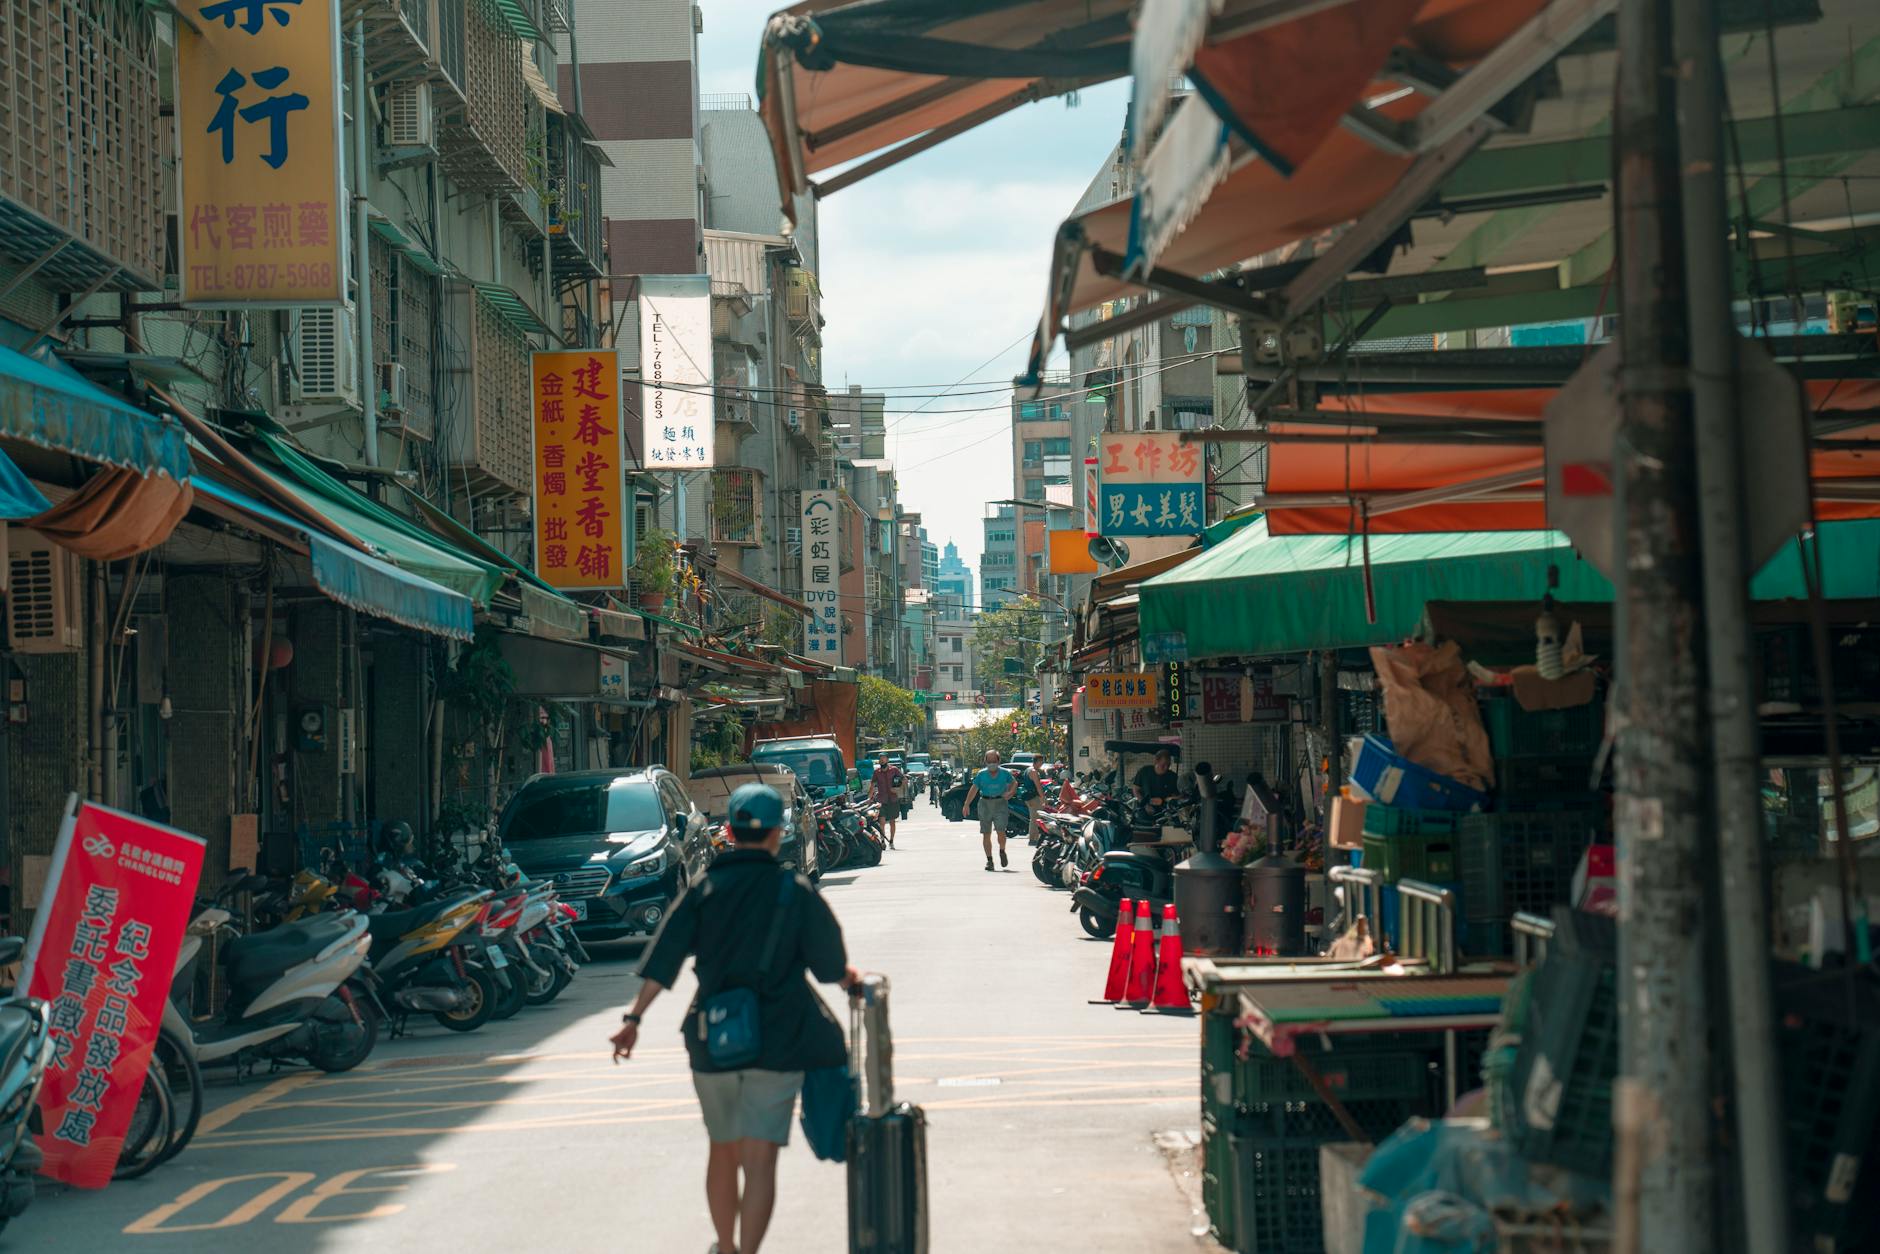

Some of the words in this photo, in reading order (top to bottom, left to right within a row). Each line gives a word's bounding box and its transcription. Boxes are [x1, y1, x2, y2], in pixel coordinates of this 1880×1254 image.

[191, 202, 329, 250] 代客煎藥
[190, 262, 332, 290] TEL:8787-5968
[572, 357, 614, 580] 建春堂香舖
[1103, 438, 1200, 478] 工作坊
[1107, 490, 1199, 529] 男女美髮
[810, 517, 831, 584] 彩虹屋
[807, 590, 836, 603] DVD
[808, 639, 837, 652] 漫畫
[54, 918, 153, 1149] 紀念品發放處
